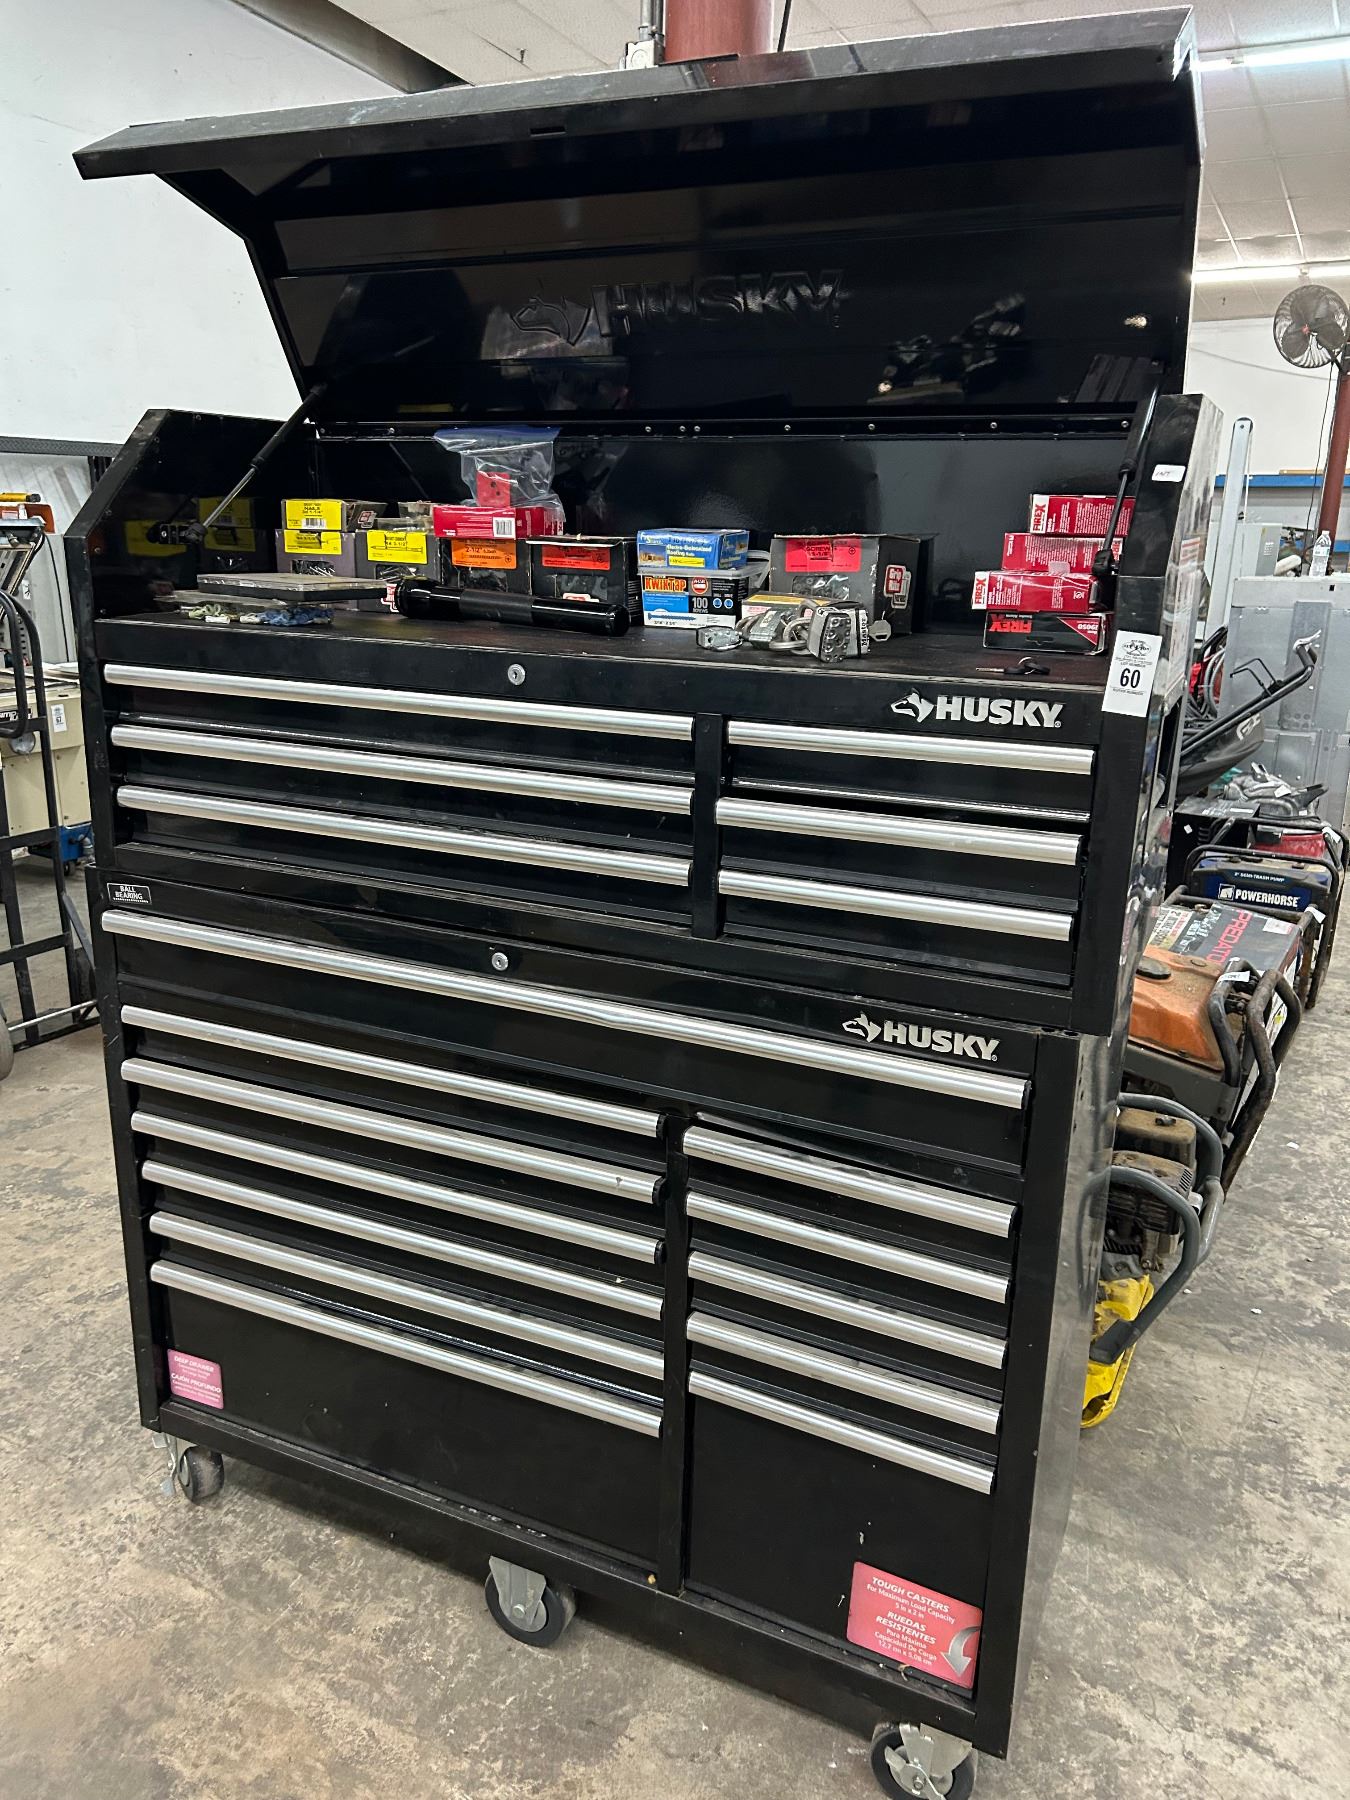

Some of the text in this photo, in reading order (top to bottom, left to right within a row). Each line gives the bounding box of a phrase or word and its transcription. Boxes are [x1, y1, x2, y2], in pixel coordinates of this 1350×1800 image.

[591, 268, 846, 337] HUSKY
[1032, 503, 1047, 531] FIREX
[465, 546, 483, 554] 2-1/2"
[692, 597, 708, 609] 100
[974, 578, 987, 604] FIREX
[989, 613, 1033, 633] FIREX
[1120, 667, 1141, 689] 60
[936, 694, 1062, 729] HUSKY
[115, 891, 143, 900] BEARING
[119, 885, 136, 893] BALL
[1235, 888, 1299, 908] POWERHORSE
[1206, 909, 1253, 964] PREDATO
[883, 1019, 1000, 1062] HUSKY
[871, 1576, 950, 1613] TOUGH CASTERS
[878, 1587, 910, 1605] Maximum
[910, 1600, 927, 1612] Load
[927, 1606, 956, 1625] Capacity
[875, 1615, 937, 1645] RESISTENTES
[887, 1610, 927, 1632] RUEDAS
[886, 1628, 901, 1640] Para
